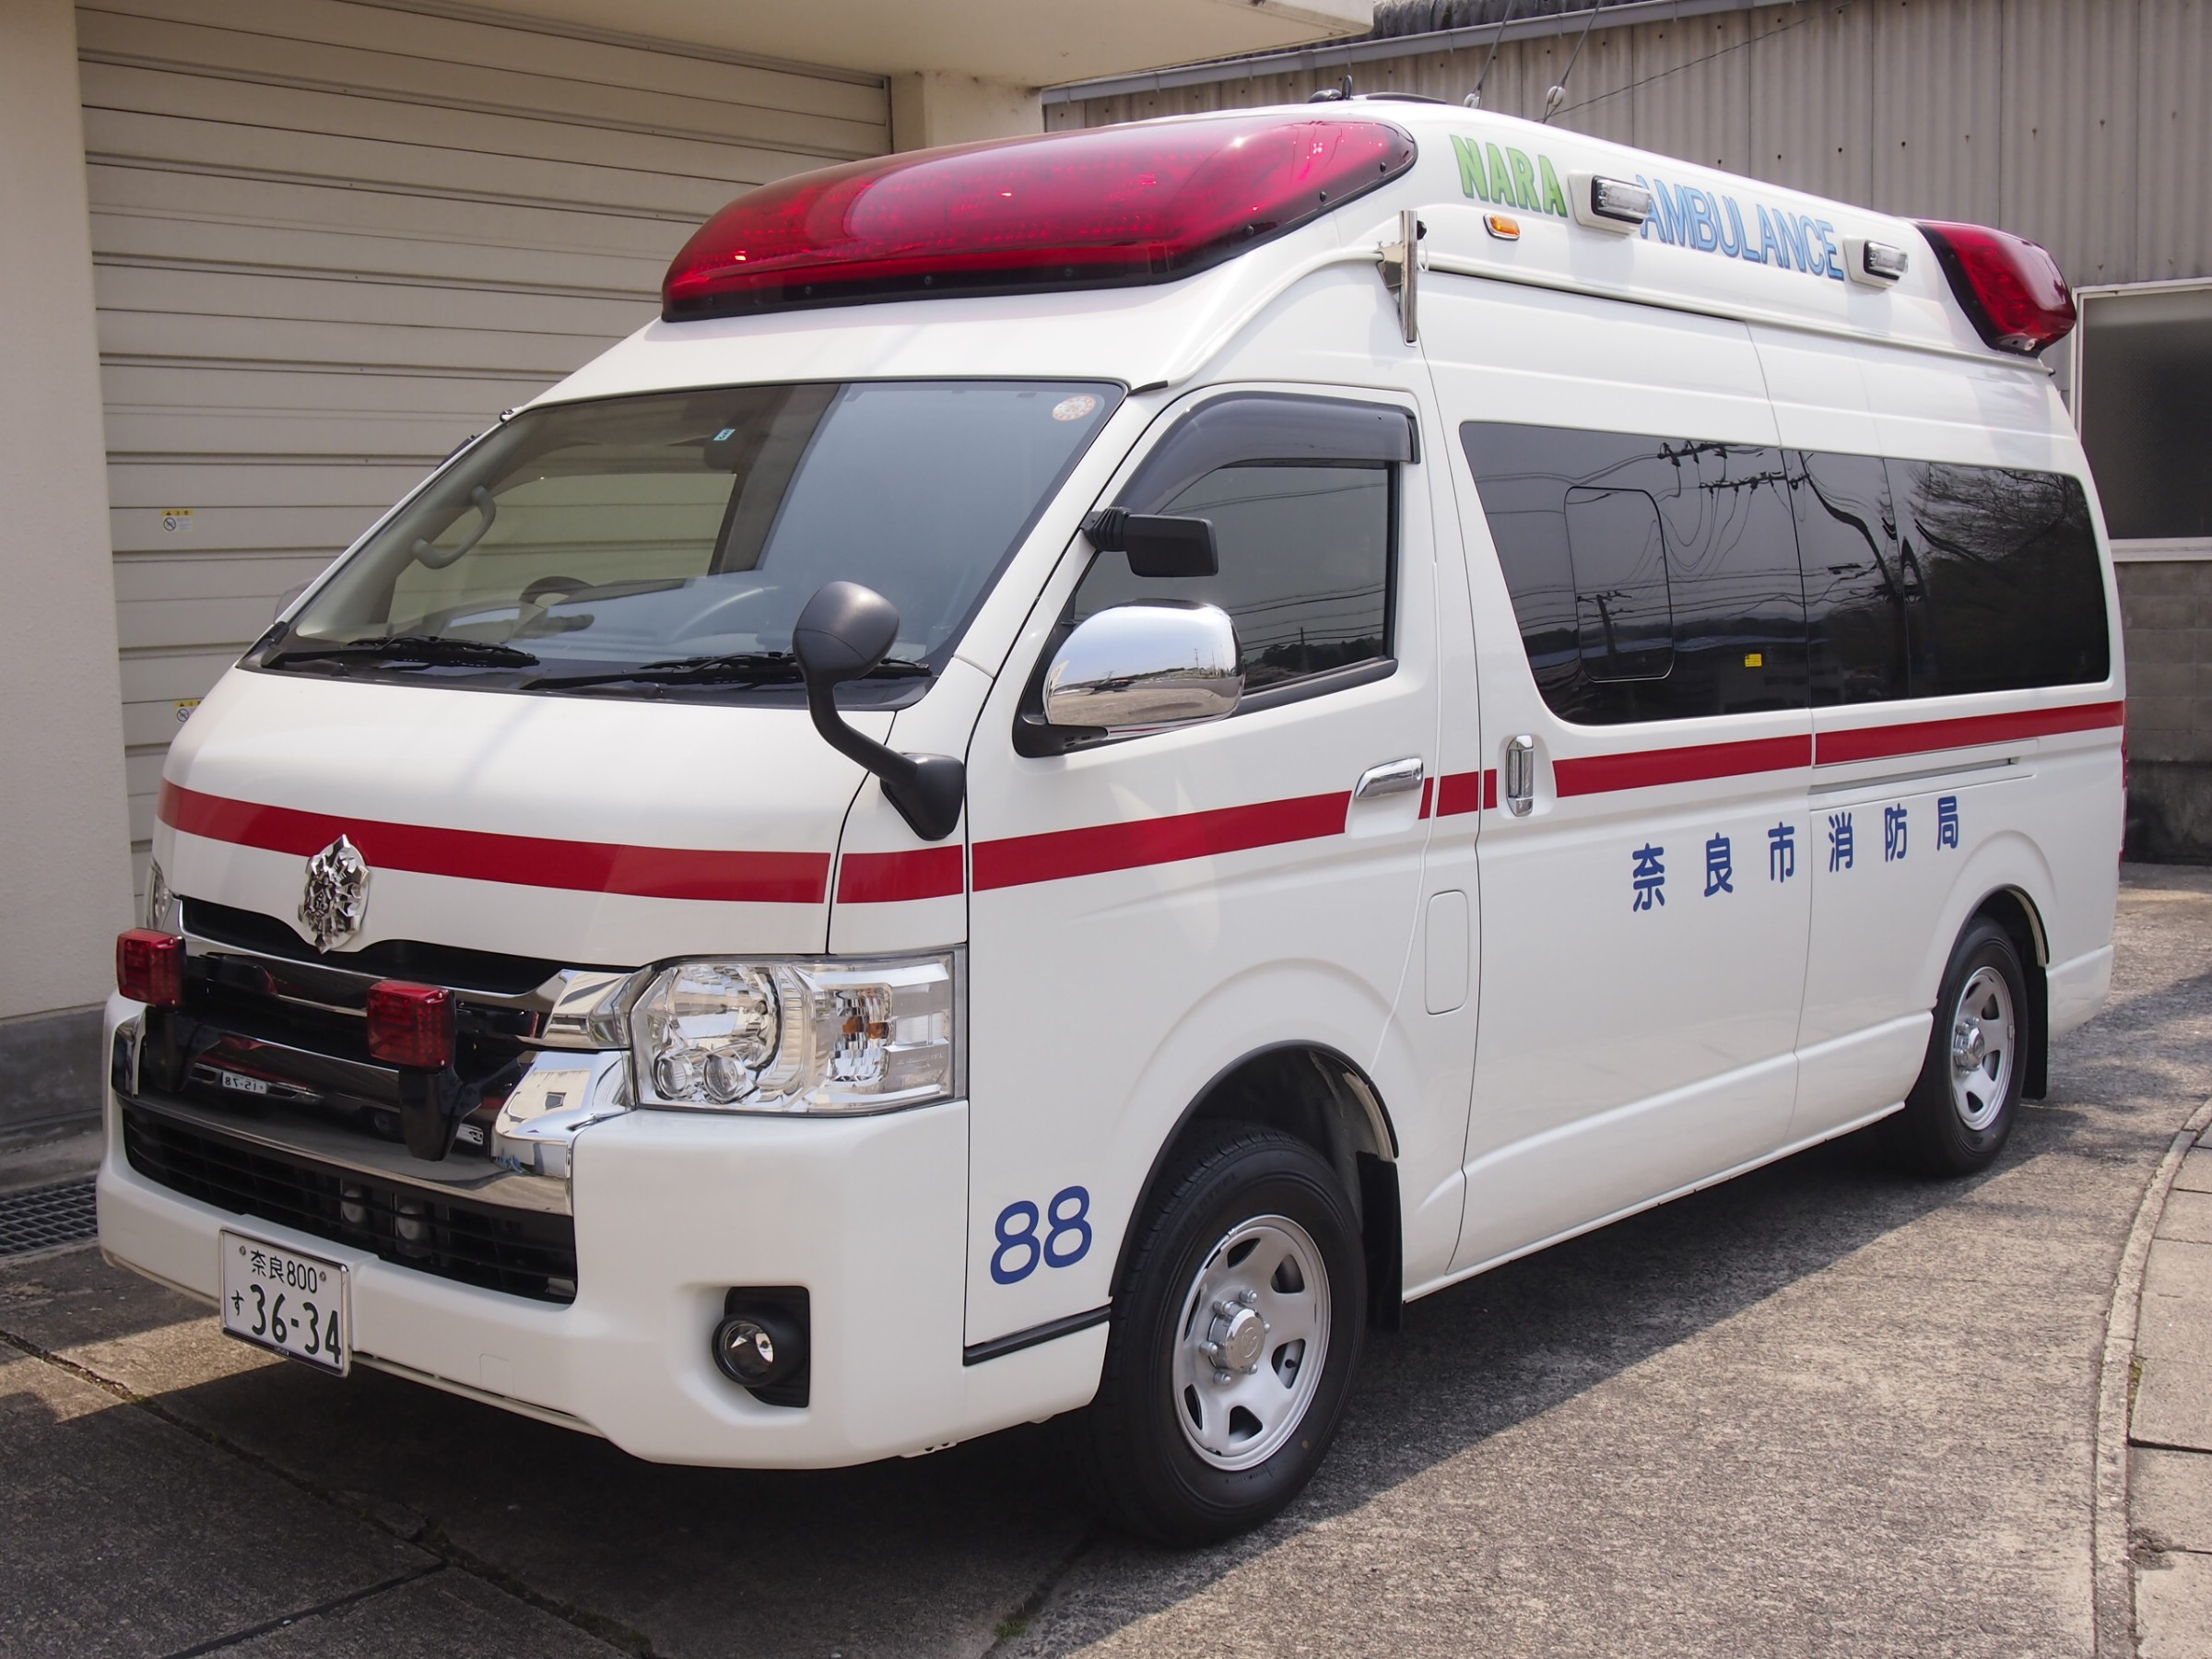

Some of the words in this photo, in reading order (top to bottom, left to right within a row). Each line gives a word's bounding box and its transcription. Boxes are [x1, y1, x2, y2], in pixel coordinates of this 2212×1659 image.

[1449, 134, 1568, 218] NARA
[1636, 174, 1844, 281] AMBULANCE
[1632, 795, 1959, 912] 奈良市消防局
[990, 1185, 1092, 1285] 88
[230, 1290, 244, 1316] す
[250, 1284, 341, 1364] 36-34
